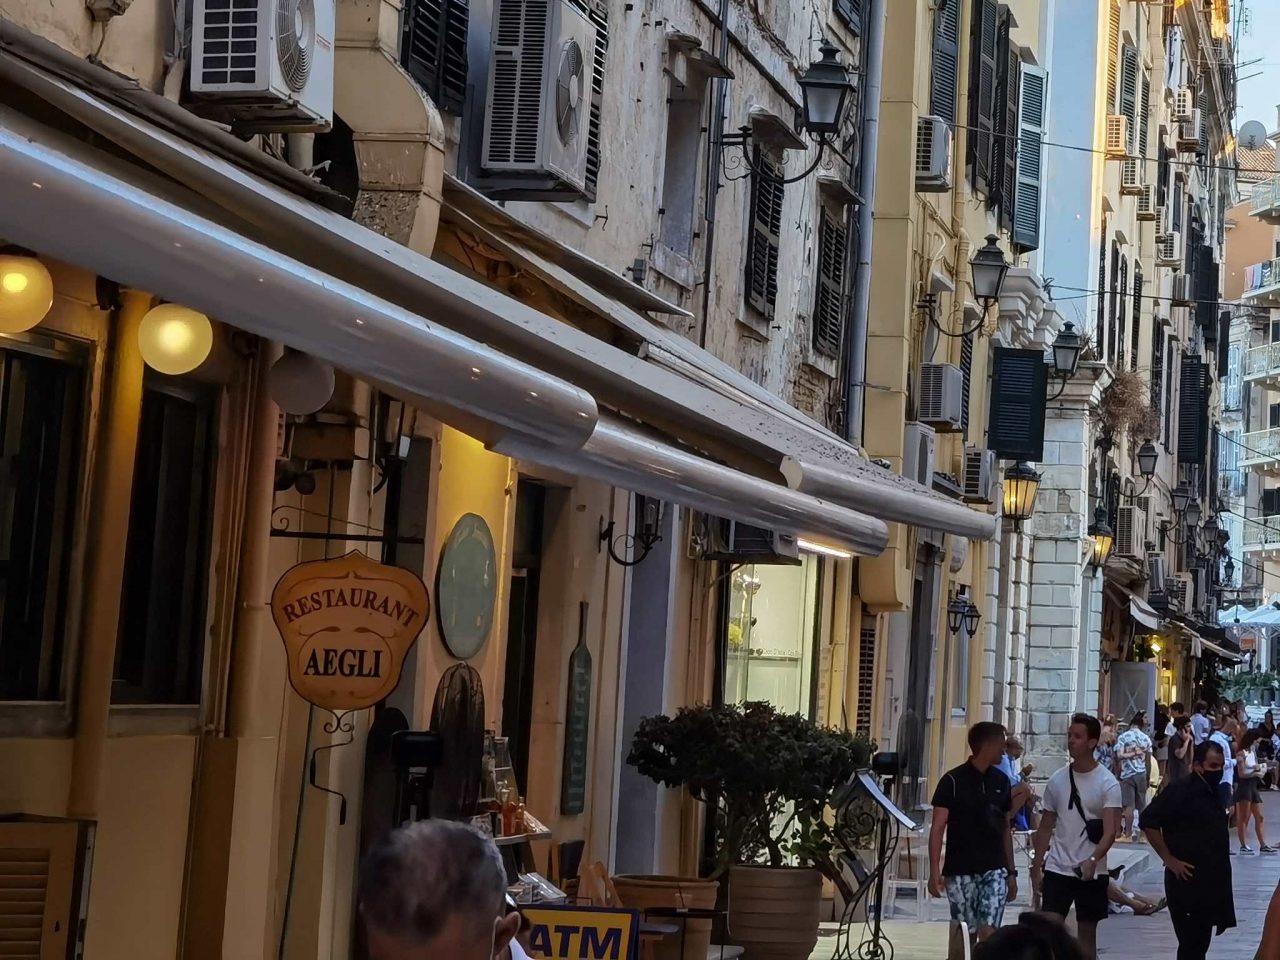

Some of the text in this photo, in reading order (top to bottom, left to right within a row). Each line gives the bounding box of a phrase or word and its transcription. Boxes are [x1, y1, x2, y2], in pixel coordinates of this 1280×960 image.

[282, 588, 419, 627] RESTAURANT
[304, 648, 382, 678] AEGLI
[530, 925, 622, 959] ATM
